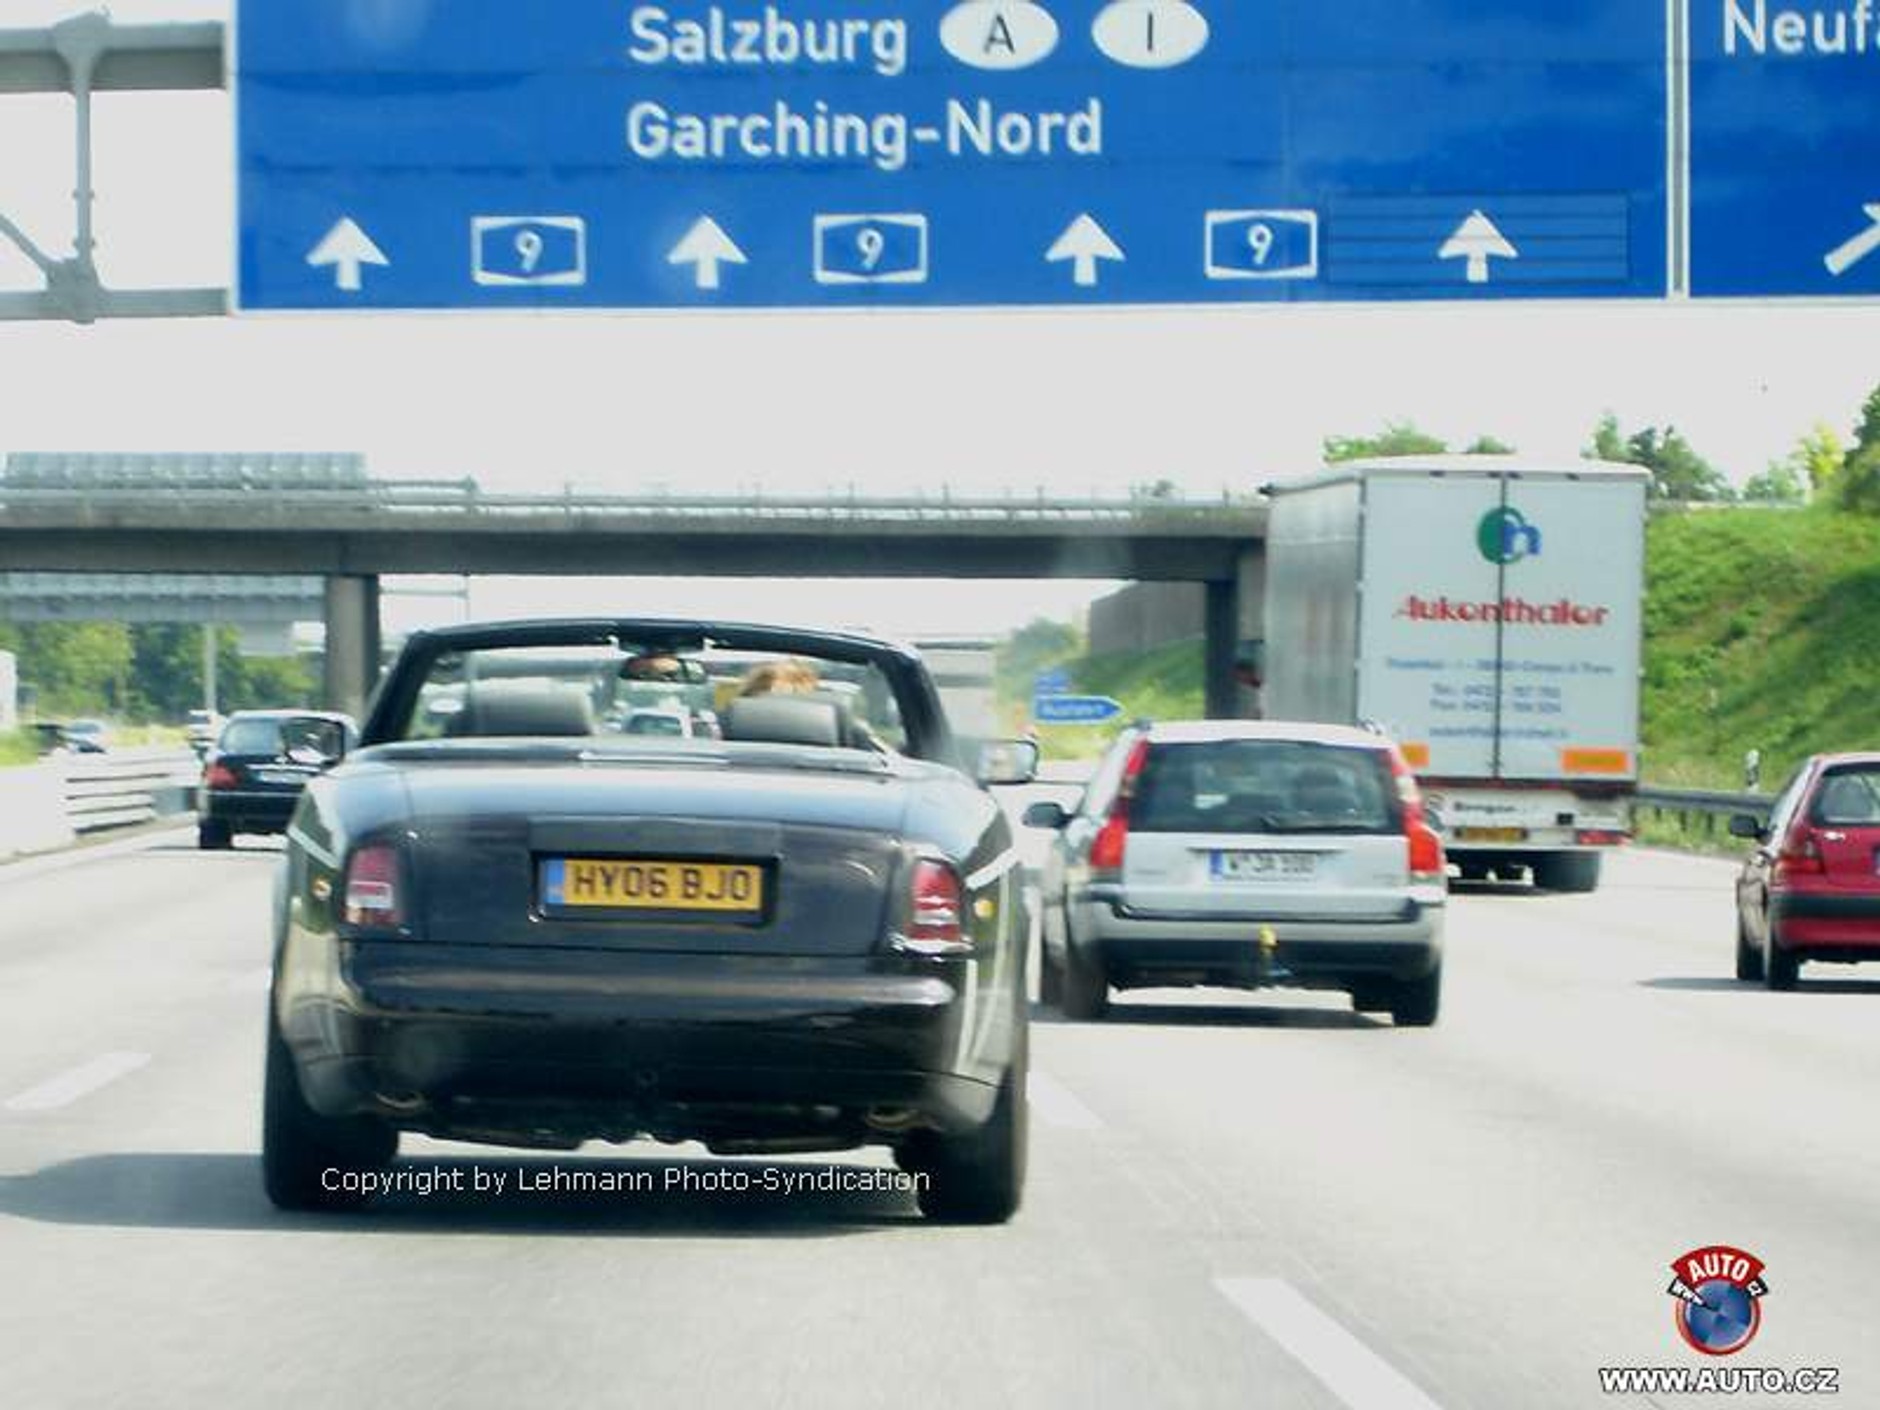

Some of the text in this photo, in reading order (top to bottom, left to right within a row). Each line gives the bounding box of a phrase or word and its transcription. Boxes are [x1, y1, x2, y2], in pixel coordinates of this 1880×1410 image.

[627, 5, 908, 76] Salzburg
[982, 12, 1017, 55] A
[1724, 0, 1880, 54] Neuf
[626, 98, 1103, 170] Garching-Nord
[513, 229, 543, 273] 9
[855, 227, 885, 270] 9
[1246, 223, 1274, 266] 9
[573, 864, 669, 898] HY06
